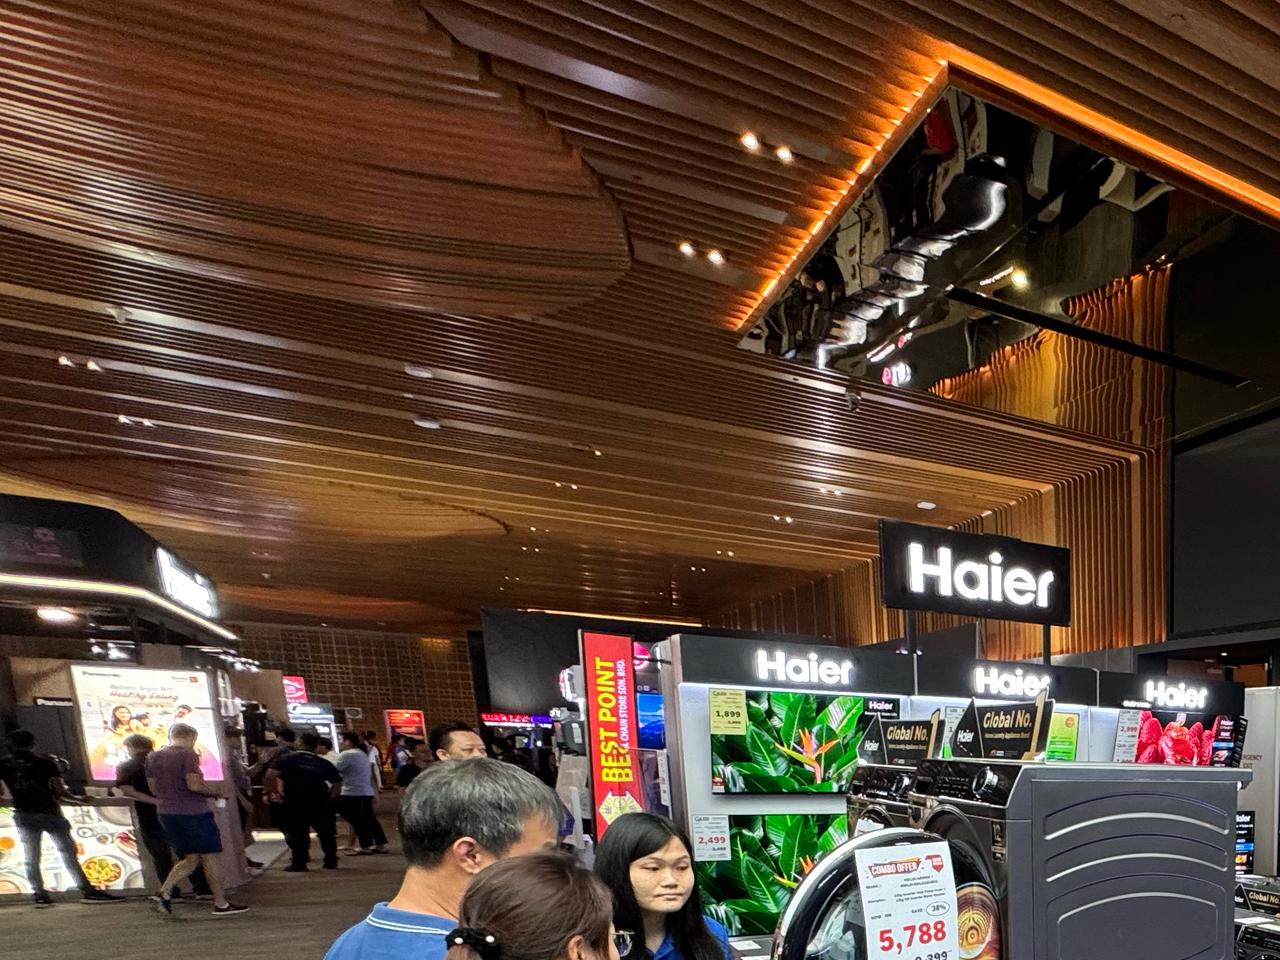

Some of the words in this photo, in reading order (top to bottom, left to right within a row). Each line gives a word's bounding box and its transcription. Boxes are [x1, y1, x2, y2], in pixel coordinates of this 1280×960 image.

[907, 541, 1055, 608] Haier
[617, 659, 626, 677] BHD.
[757, 650, 854, 685] Haier
[594, 656, 617, 722] POINT
[618, 678, 626, 695] SDN.
[974, 668, 1051, 697] Haier
[1145, 680, 1208, 708] Haier
[619, 696, 628, 718] STORE
[715, 710, 741, 718] 1,899
[869, 701, 893, 710] Haier
[983, 711, 1016, 729] Global
[1017, 709, 1032, 728] No.
[1021, 690, 1047, 760] 1
[620, 719, 629, 742] CHAIN
[886, 726, 912, 741] Global
[914, 725, 928, 740] No.
[927, 708, 941, 759] 1
[957, 730, 975, 743] Haier
[599, 727, 618, 783] BEST
[864, 740, 879, 751] Haier
[698, 836, 726, 845] 2,499
[871, 863, 897, 875] COMBO
[897, 861, 918, 873] OFFER
[1248, 891, 1269, 902] Global
[1269, 894, 1280, 905] No.
[879, 919, 947, 955] 5,788
